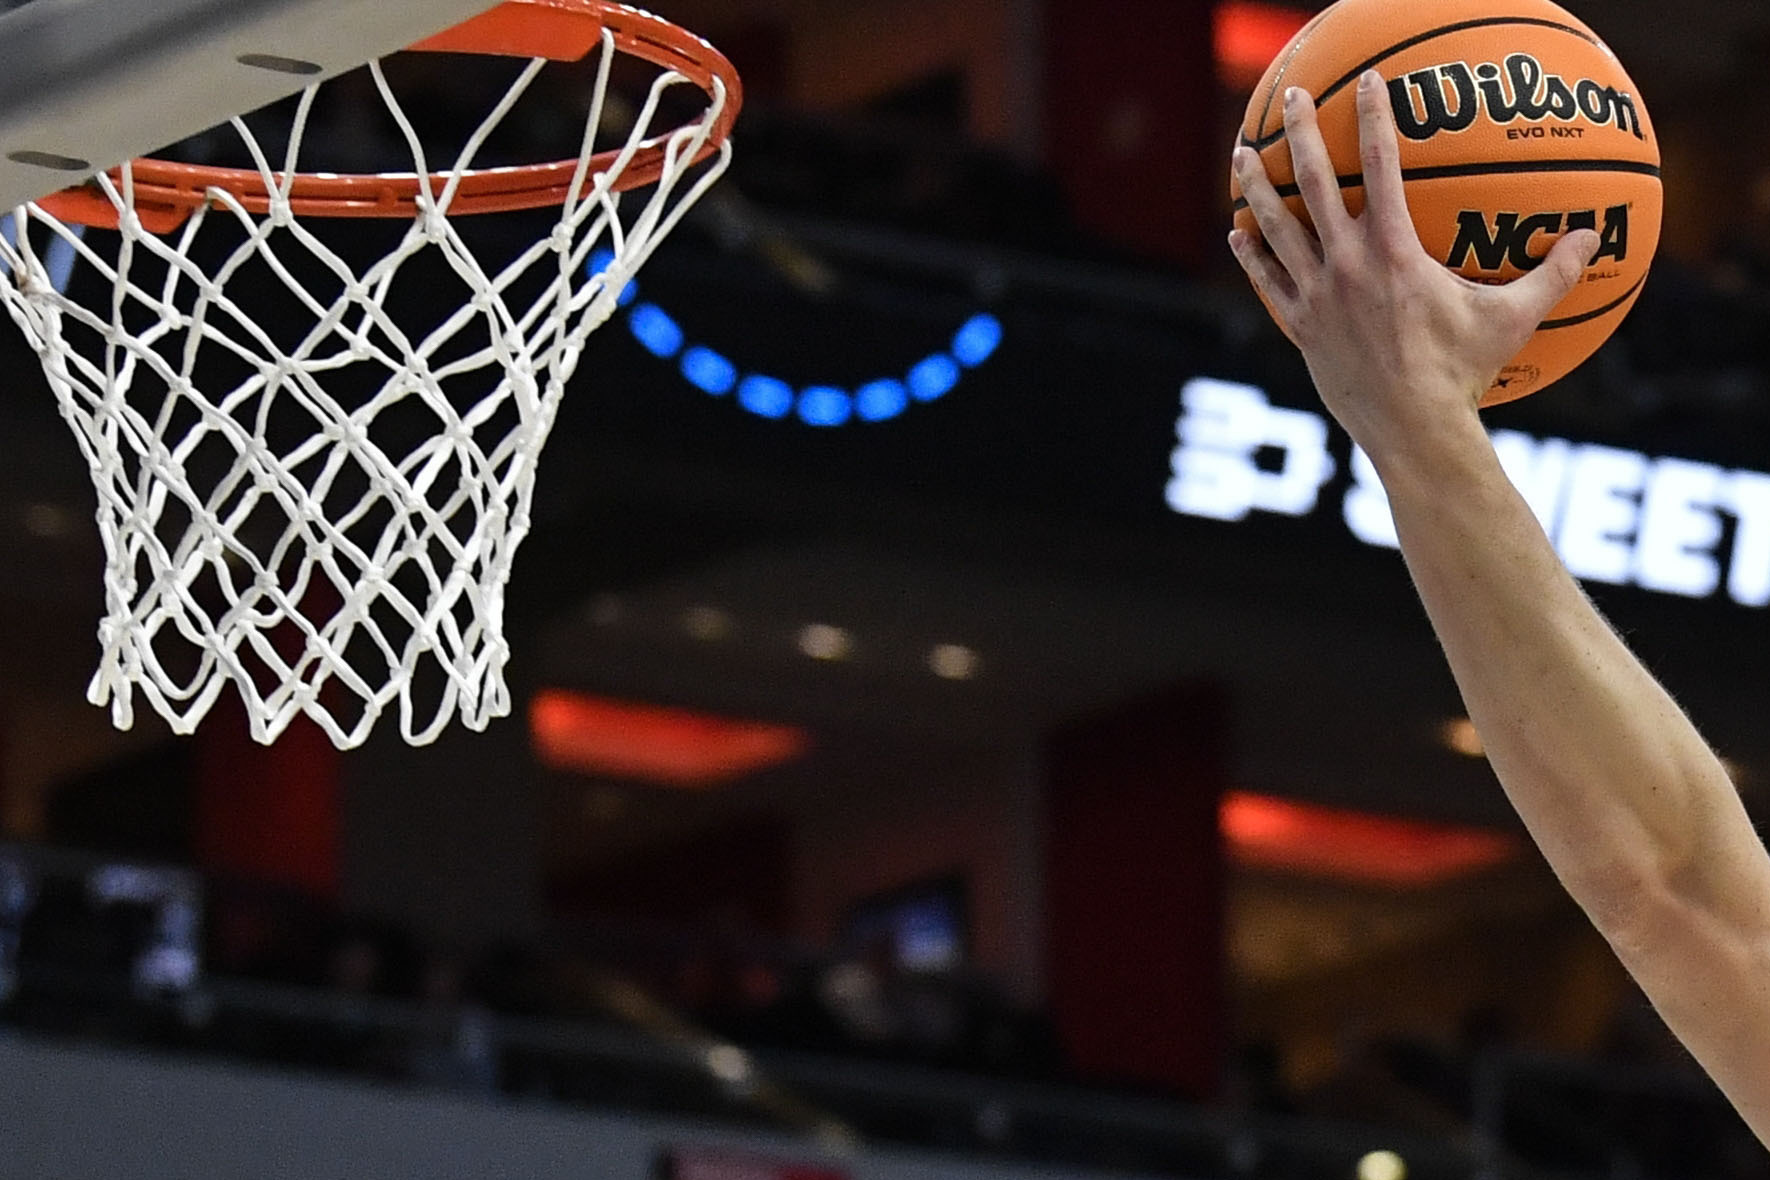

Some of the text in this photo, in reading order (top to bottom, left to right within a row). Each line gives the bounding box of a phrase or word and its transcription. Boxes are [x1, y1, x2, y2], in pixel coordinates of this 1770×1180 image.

[1387, 52, 1643, 142] Wilson
[1506, 127, 1585, 141] EVO NXT
